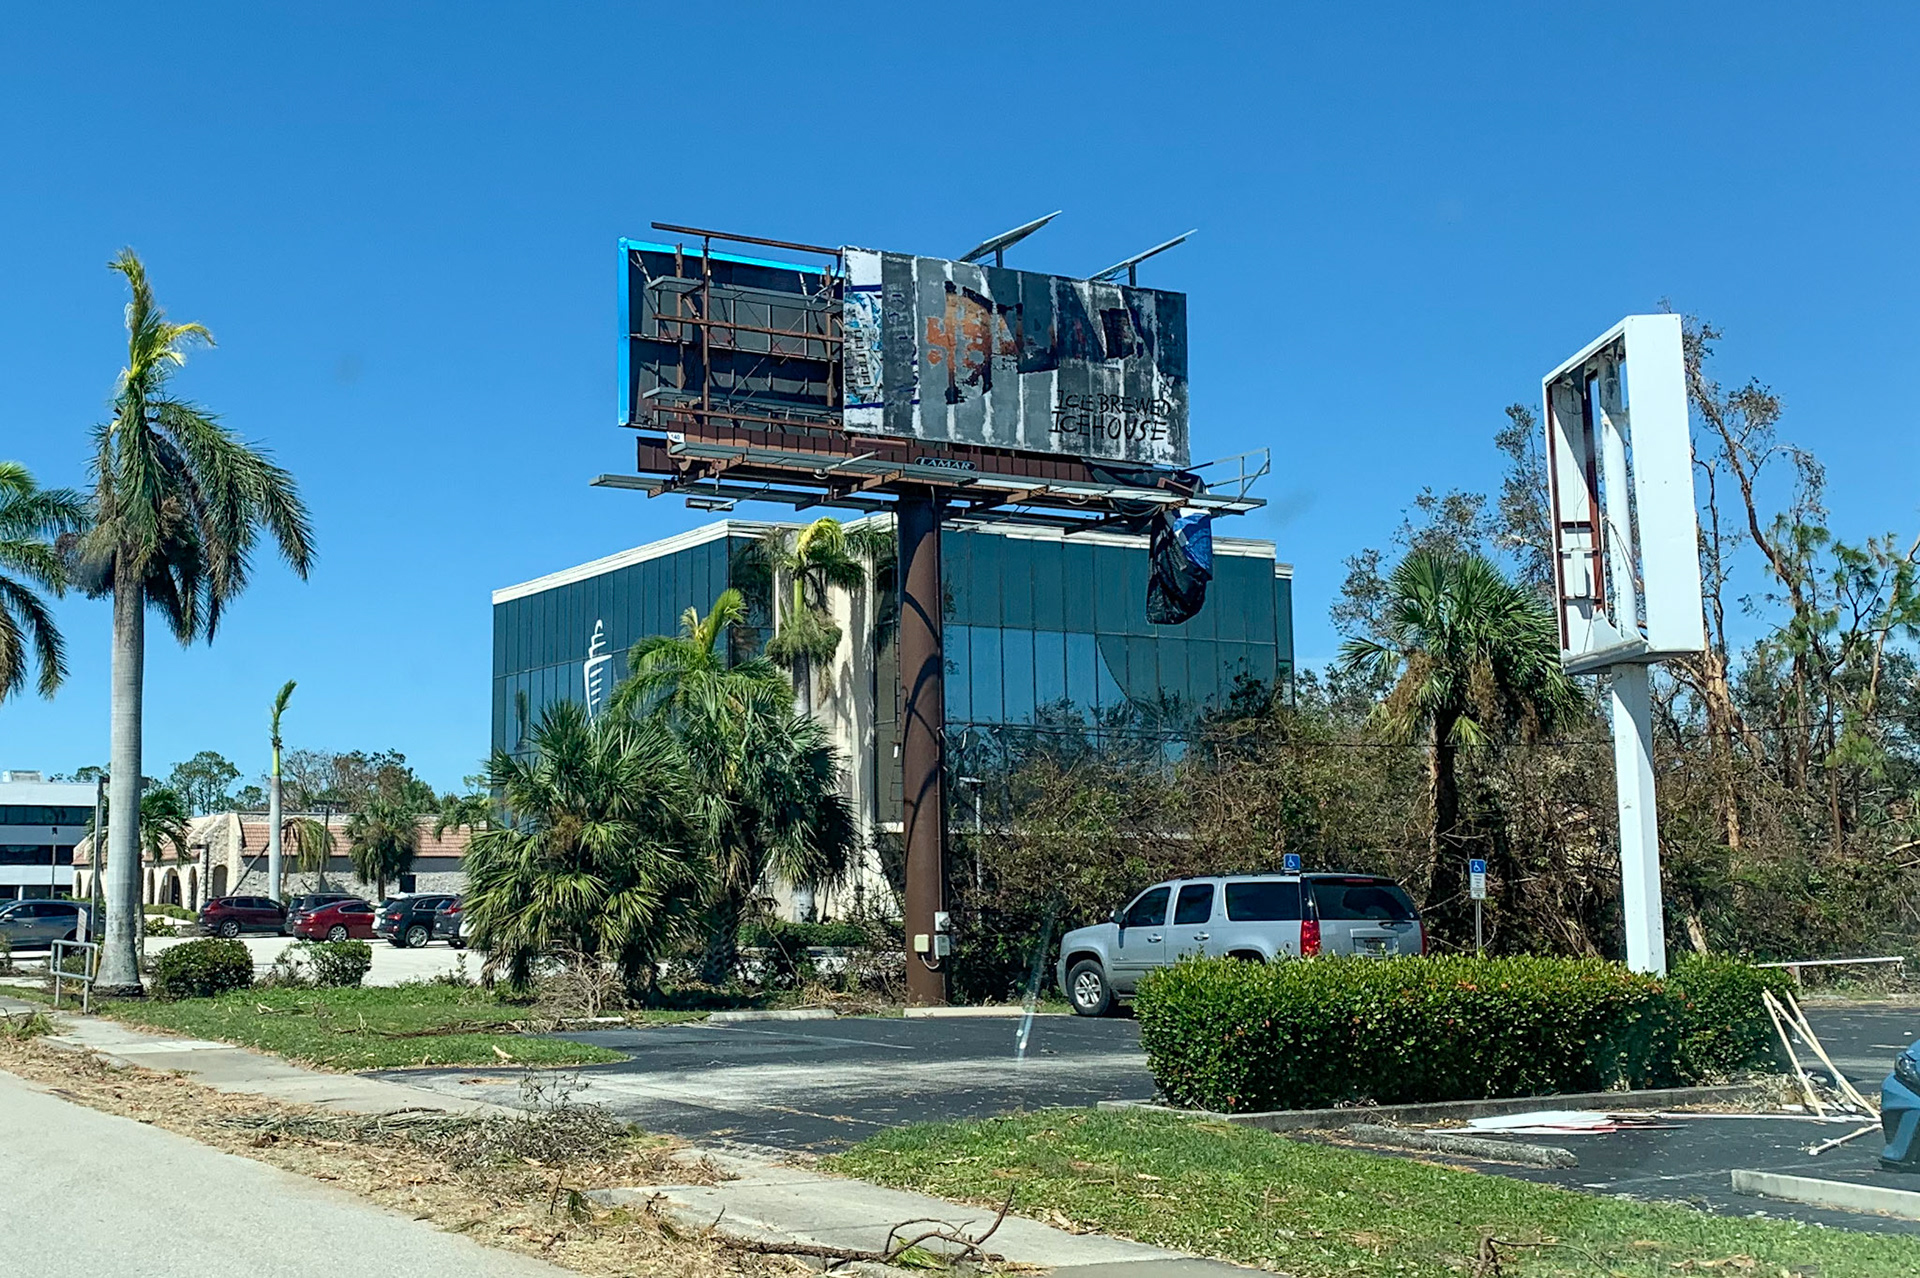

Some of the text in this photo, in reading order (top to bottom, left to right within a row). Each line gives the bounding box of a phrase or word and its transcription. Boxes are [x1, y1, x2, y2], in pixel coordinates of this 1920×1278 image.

[1054, 389, 1171, 417] ICE BREWED
[1048, 410, 1167, 441] ICEHOUSE
[919, 458, 971, 471] LAMAR
